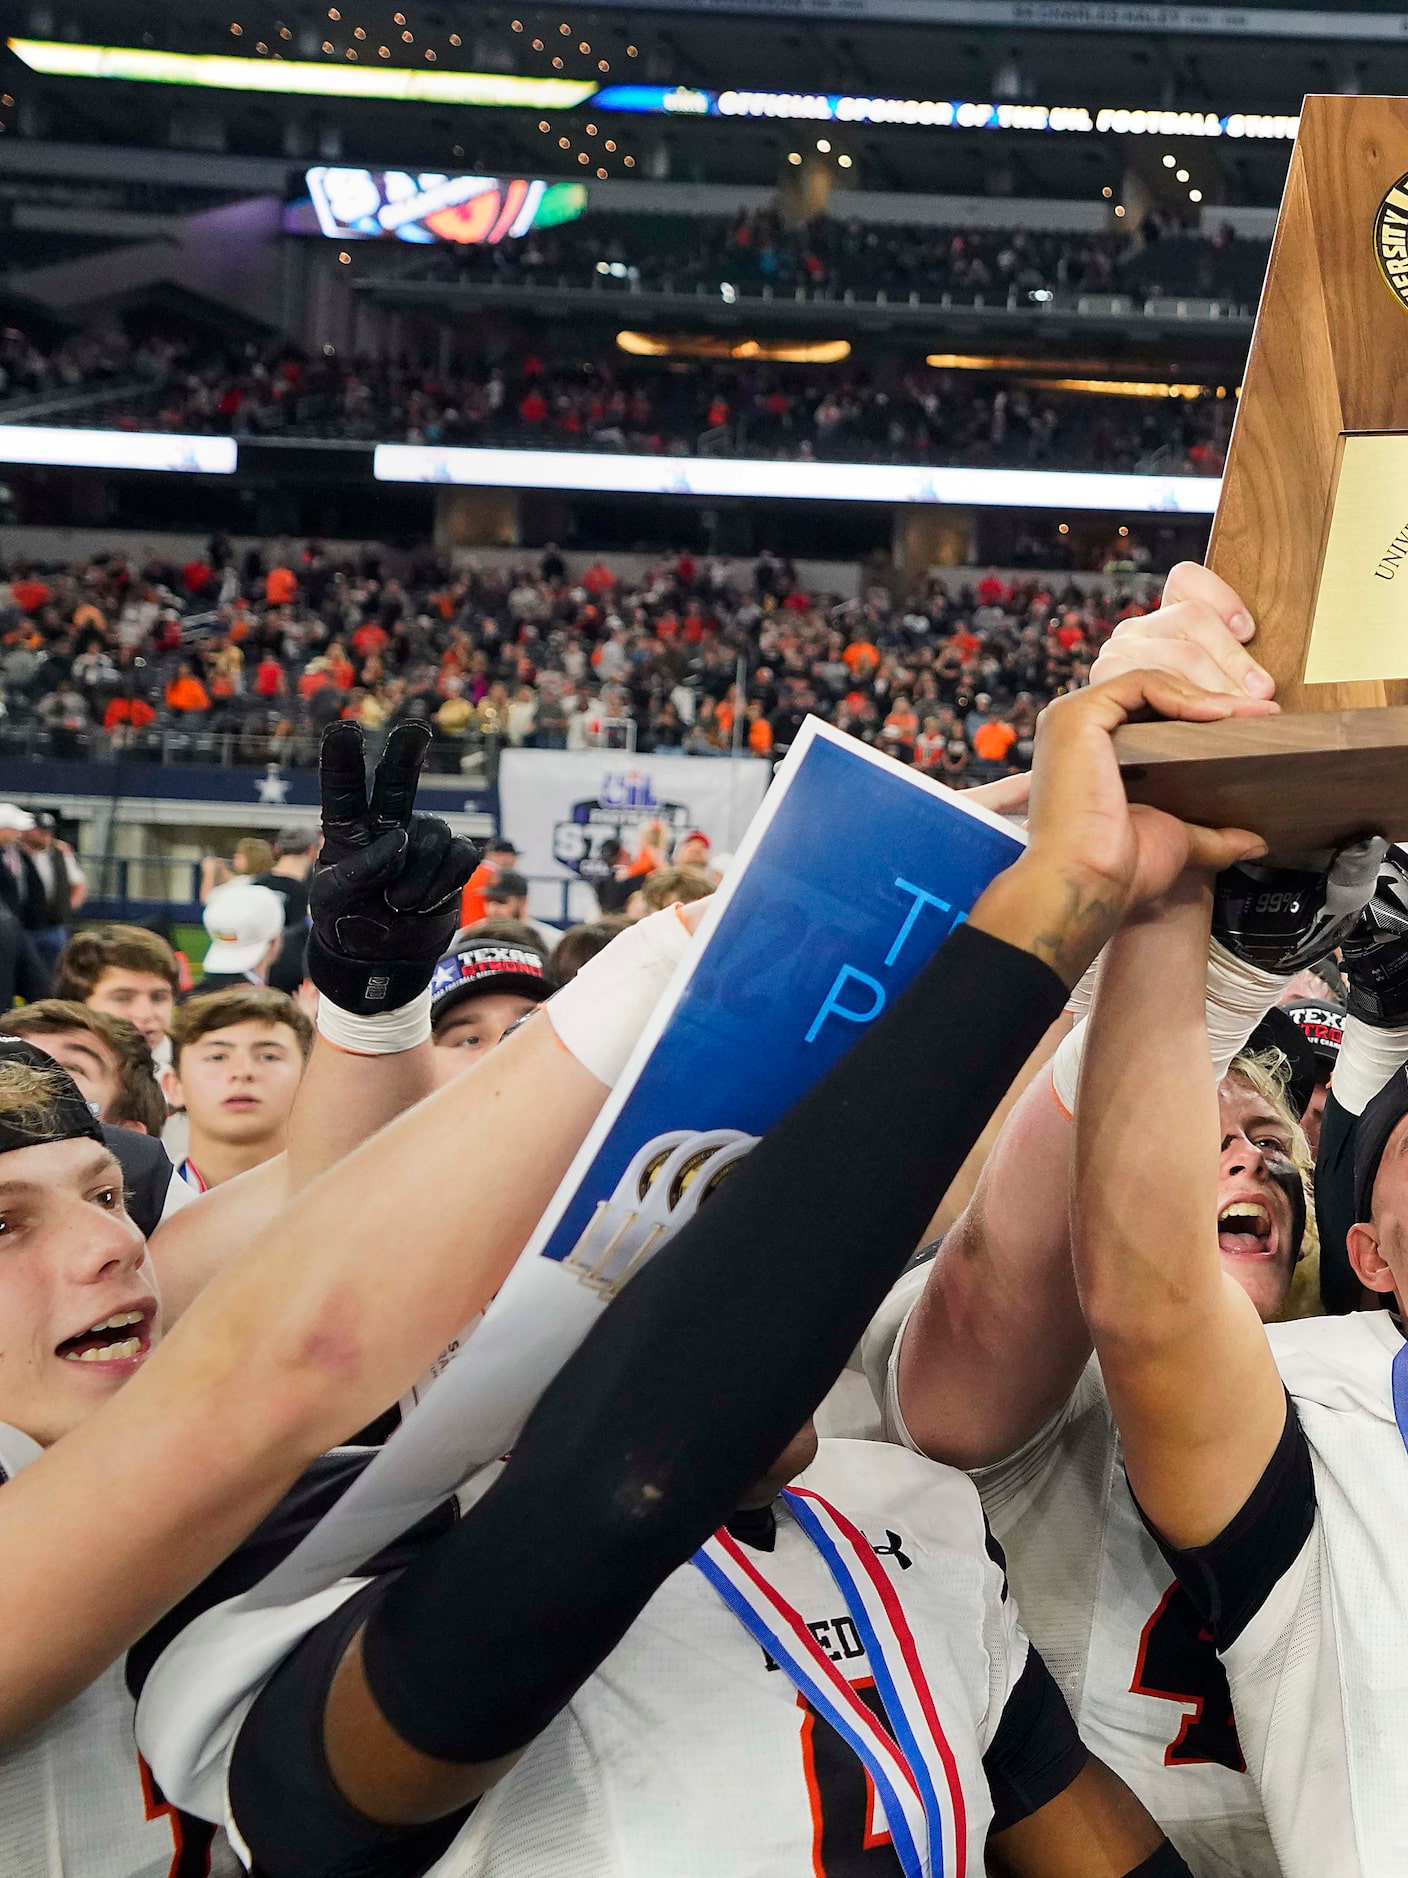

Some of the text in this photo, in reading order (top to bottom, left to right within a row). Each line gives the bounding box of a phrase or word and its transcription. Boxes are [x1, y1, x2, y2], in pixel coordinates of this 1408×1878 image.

[458, 947, 543, 968] TEXAS
[1289, 1008, 1345, 1032] TEX
[1299, 1023, 1342, 1045] TRO
